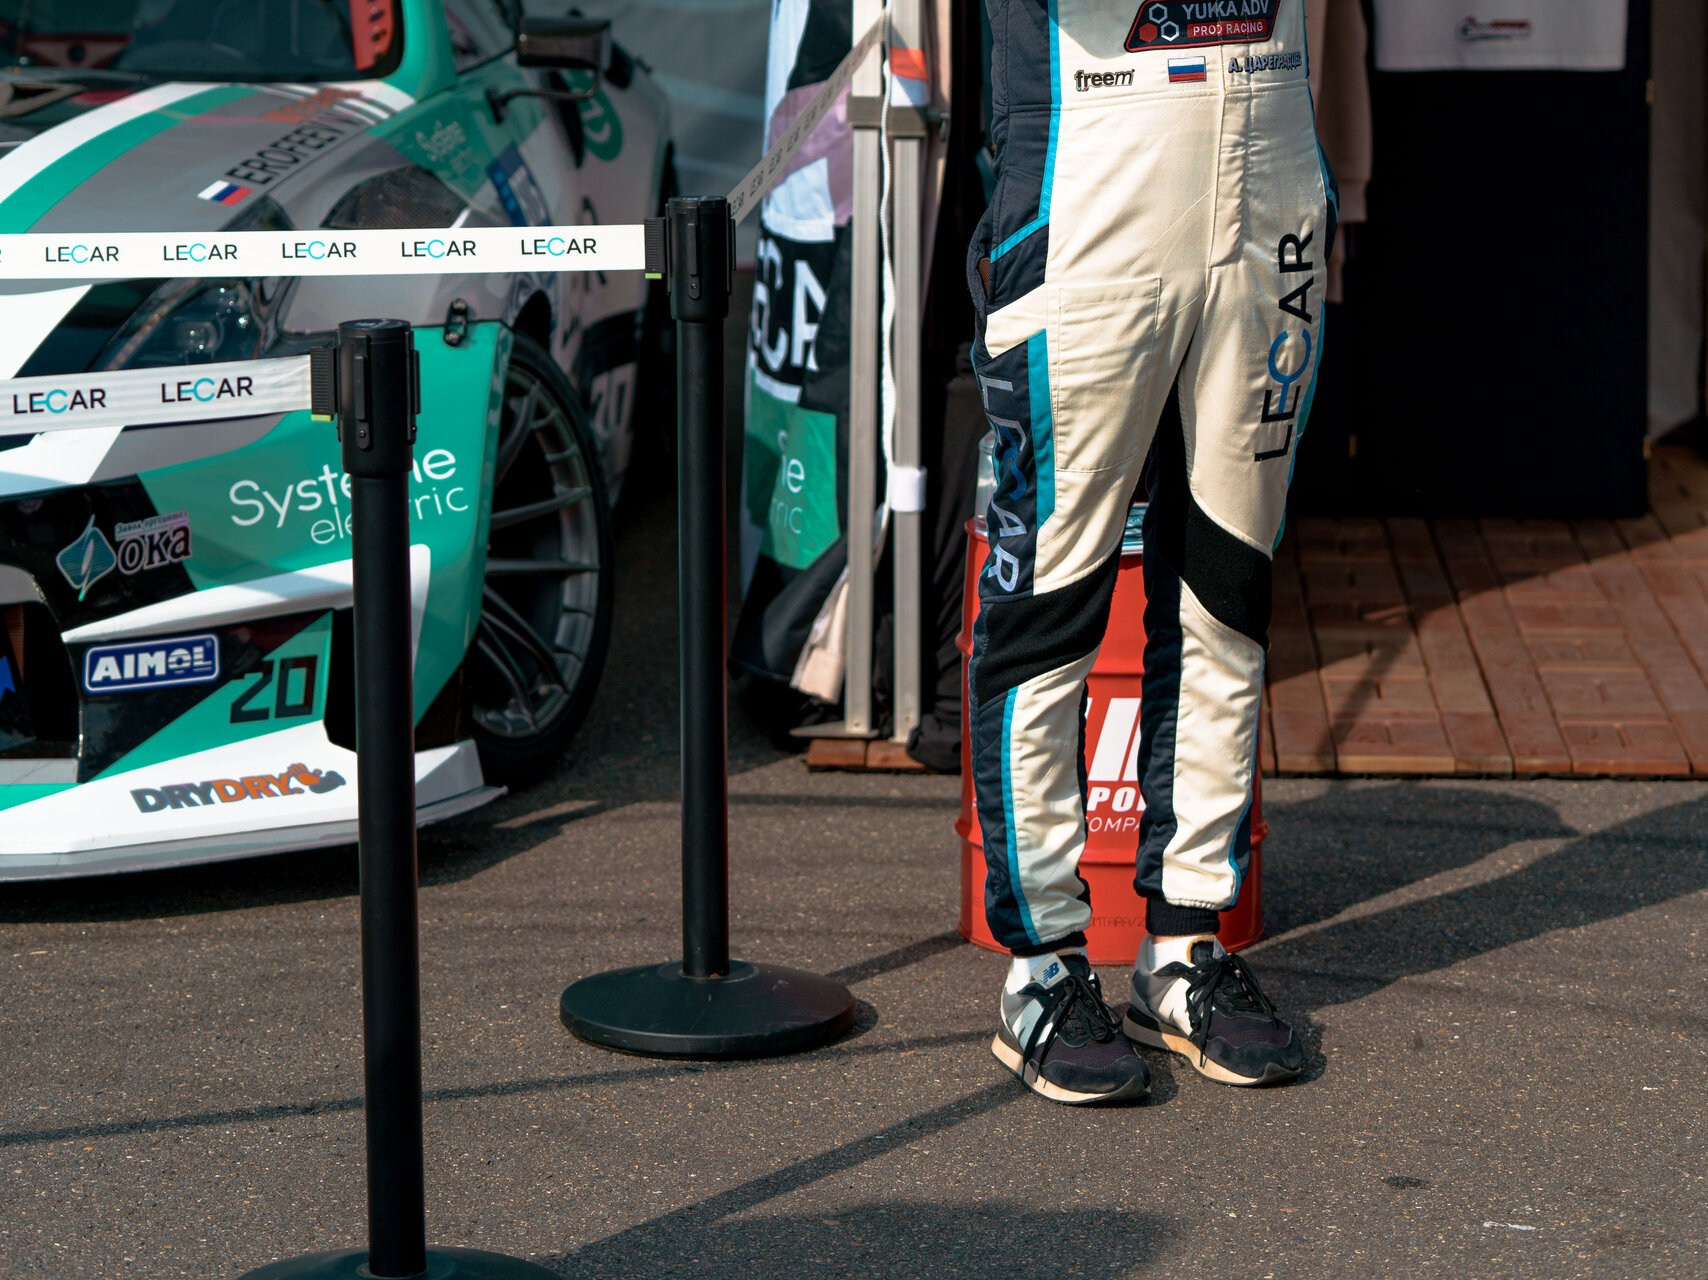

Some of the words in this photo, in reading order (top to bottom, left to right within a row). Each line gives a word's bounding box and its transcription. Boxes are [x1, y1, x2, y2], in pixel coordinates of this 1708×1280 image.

[1225, 21, 1264, 35] RACING
[46, 245, 120, 263] LECAR
[163, 243, 238, 262] LECAR
[281, 240, 357, 260] LECAR
[401, 239, 477, 258] LECAR
[521, 237, 597, 256] LECAR
[1253, 229, 1314, 462] LECAR
[13, 389, 106, 414] LECAR
[161, 376, 254, 403] LECAR
[91, 645, 213, 682] AIMOL
[229, 655, 319, 724] 20
